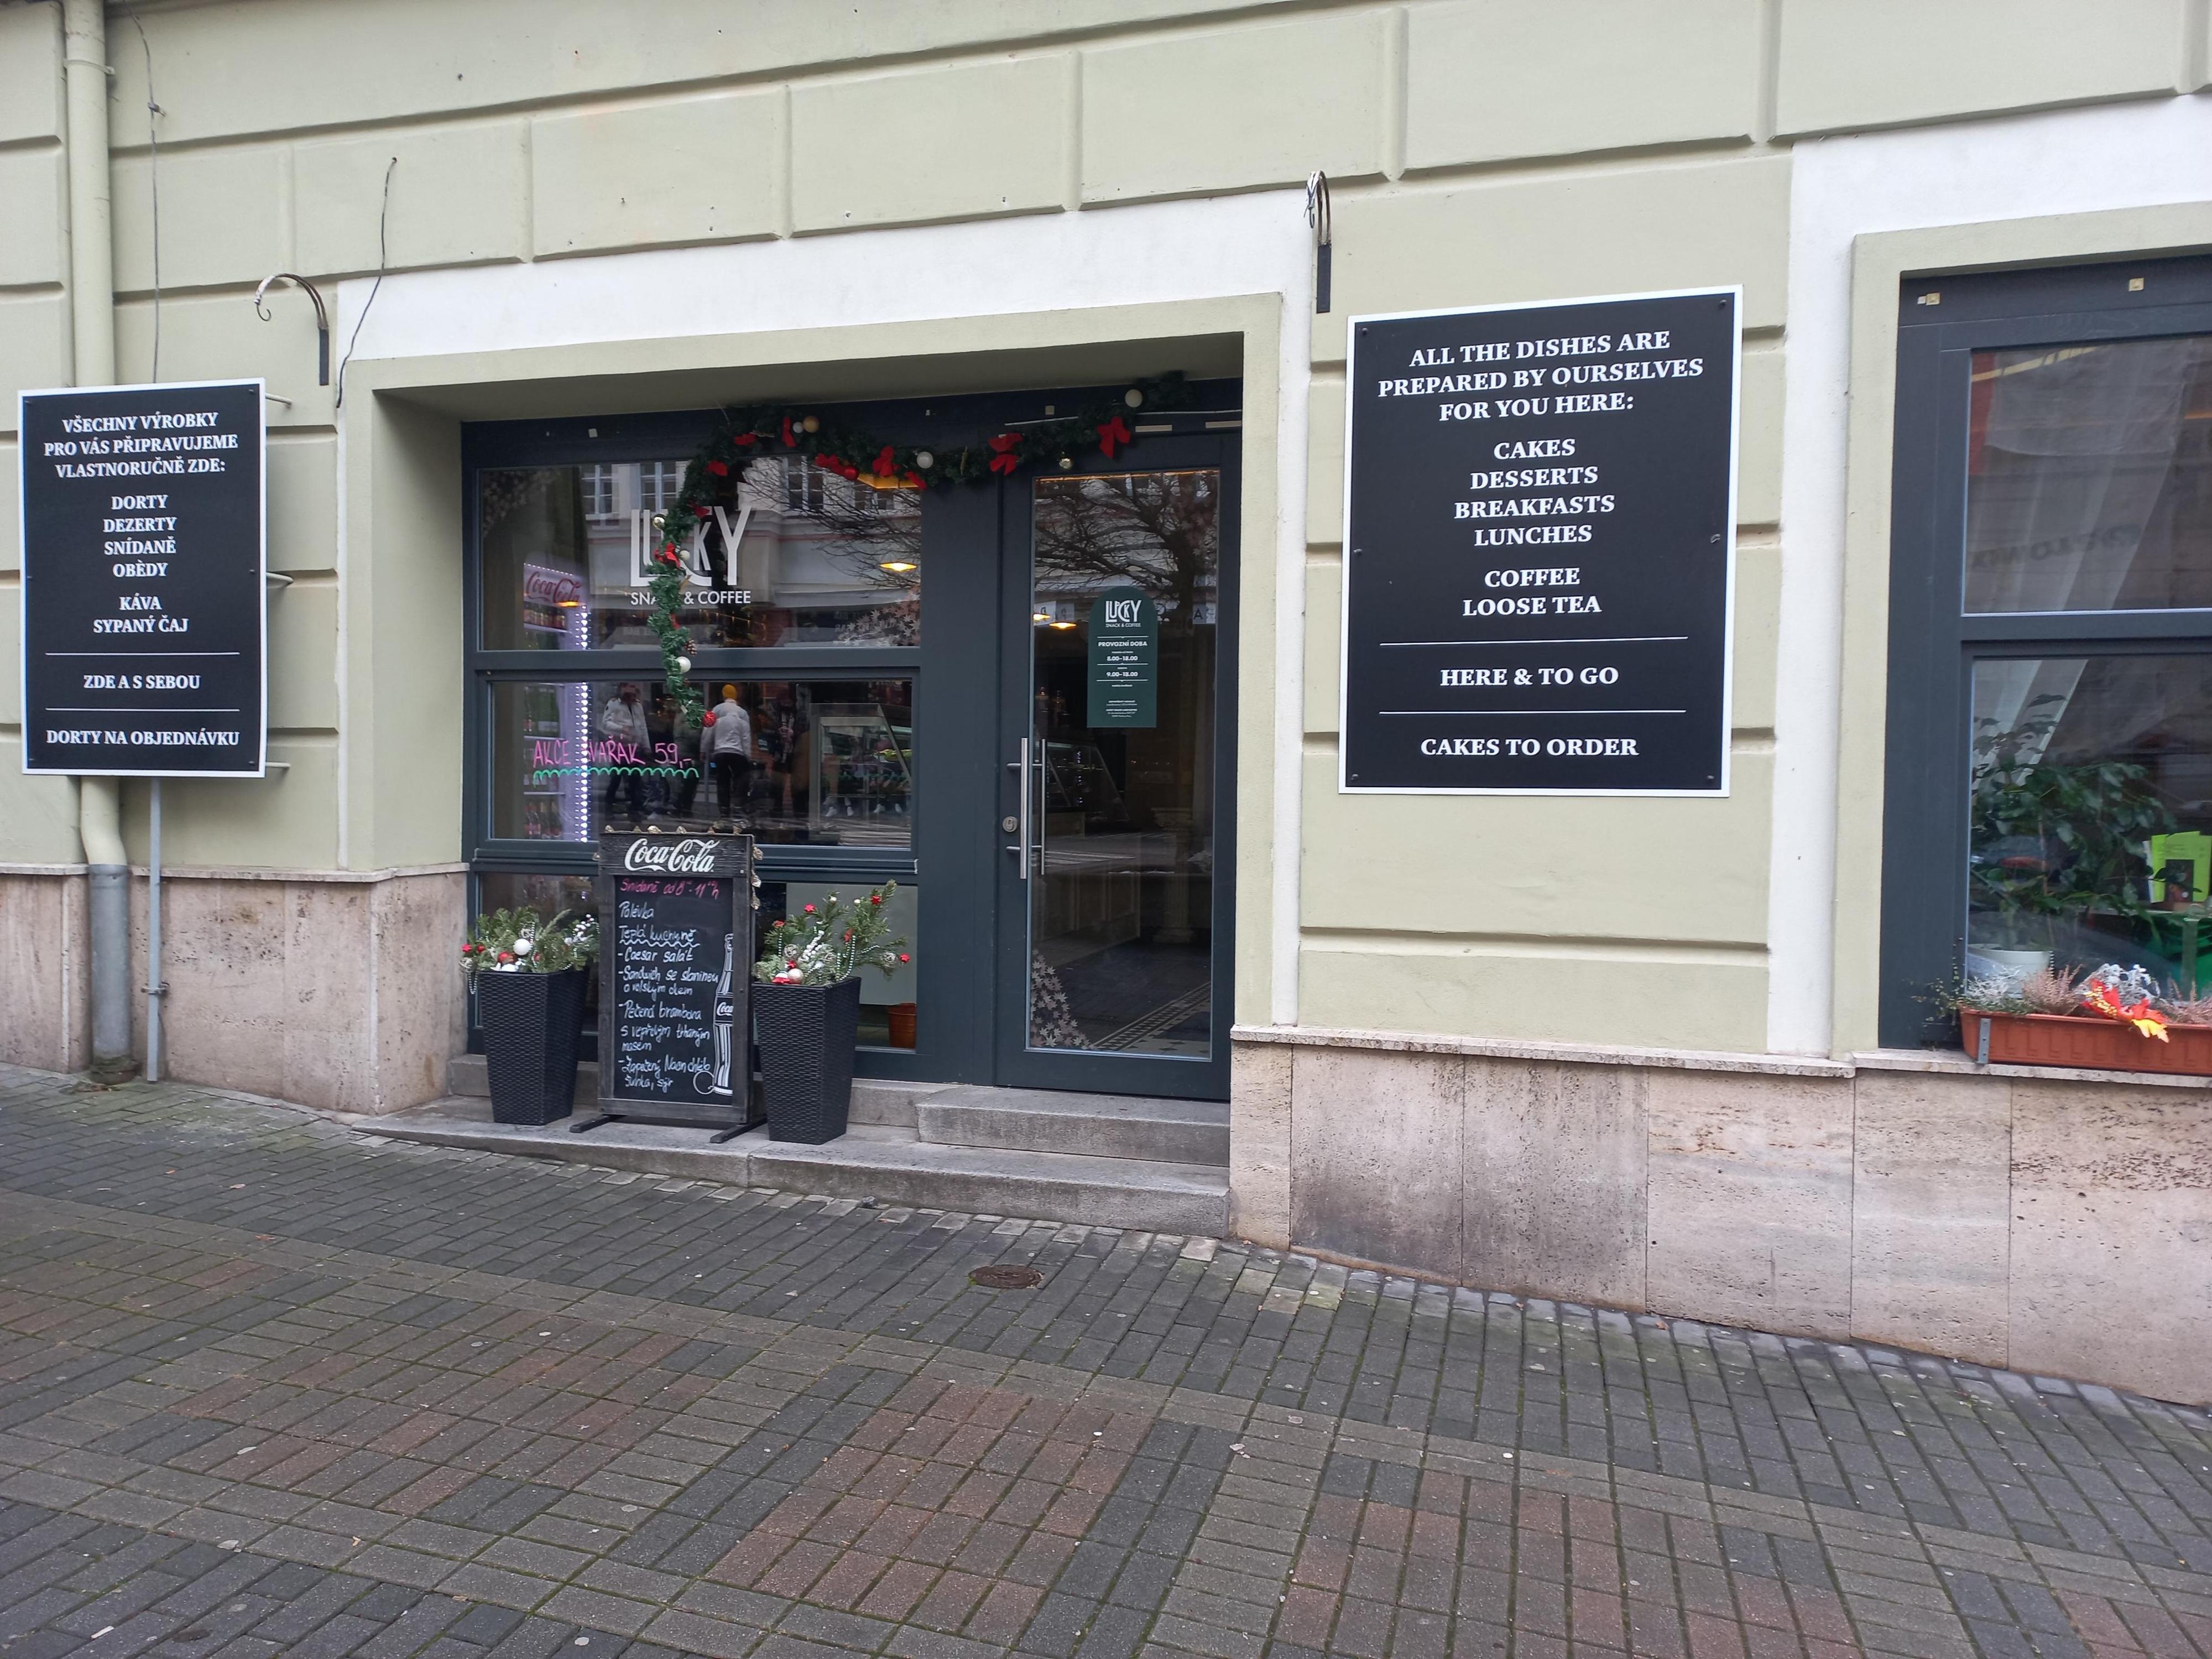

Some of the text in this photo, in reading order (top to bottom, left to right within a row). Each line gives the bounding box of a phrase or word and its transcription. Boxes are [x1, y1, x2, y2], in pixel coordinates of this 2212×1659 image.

[1409, 331, 1670, 367] ALL THE DISHES ARE
[1378, 358, 1703, 397] PREPARED BY OURSELVES
[1439, 393, 1633, 421] FOR YOU HERE:
[62, 411, 218, 432] VŠECHNY VÝROBKY
[44, 434, 238, 456] PRO VÁS PŘIPRAVUJEME
[1494, 439, 1575, 460] CAKES
[55, 457, 225, 478] VLASTNORUČNĚ ZDE:
[1470, 466, 1598, 489] DESSERTS
[111, 495, 168, 509] DORTY
[1454, 495, 1614, 519] BREAKFASTS
[103, 517, 177, 532] DEZERTY
[1474, 525, 1592, 546] LUNCHES
[105, 536, 176, 555] SNÍDANĚ
[1485, 568, 1580, 587] COFFEE
[119, 593, 162, 610] KÁVA
[684, 591, 751, 604] & COFFEE
[1463, 596, 1602, 615] LOOSE TEA
[93, 615, 189, 633] SYPANÝ ČAJ
[84, 675, 200, 688] ZDE A S SEBOU
[1441, 667, 1618, 686] HERE & TO GO
[46, 728, 239, 745] DORTY NA OBJEDNÁVKU
[533, 740, 571, 768] AKCE
[1421, 739, 1639, 755] CAKES TO ORDER
[624, 838, 720, 872] Coca-Cola
[663, 947, 693, 963] salát
[665, 969, 678, 981] se
